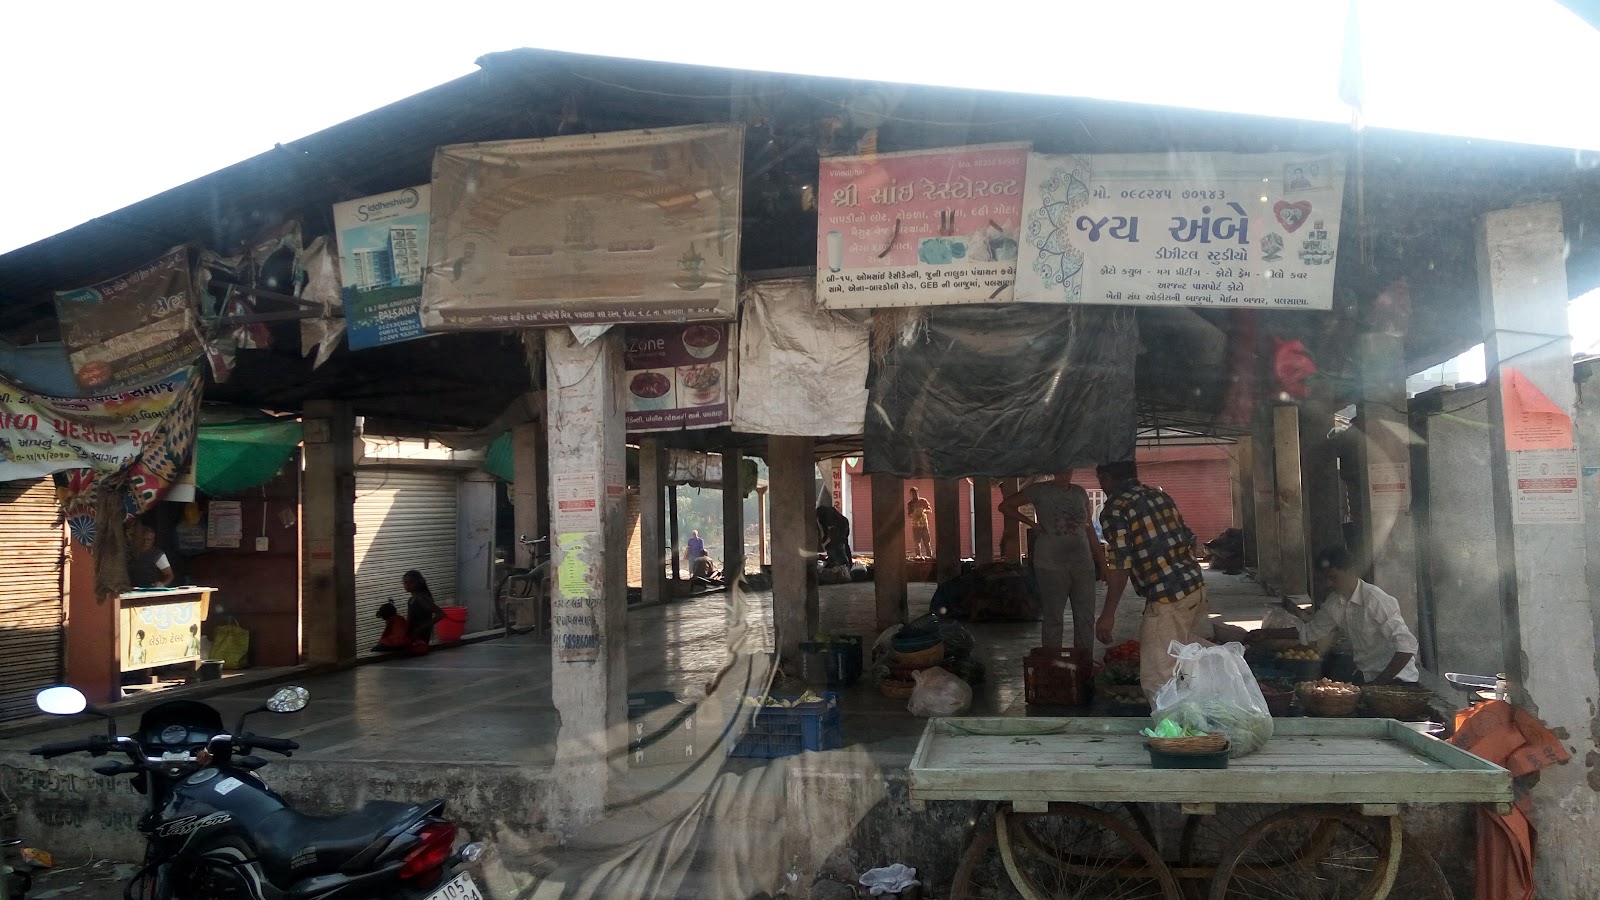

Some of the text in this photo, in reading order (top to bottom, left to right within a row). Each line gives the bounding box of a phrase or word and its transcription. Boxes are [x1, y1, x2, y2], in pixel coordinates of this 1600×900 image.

[831, 183, 861, 207] શ્રી
[1093, 185, 1226, 200] મો. ૦૯૮૨૪૫ ૭૦૧૪૩
[1076, 202, 1250, 245] જય અંબે
[1266, 268, 1284, 278] ીલો
[920, 281, 938, 289] GEB
[378, 305, 417, 320] PALSANA
